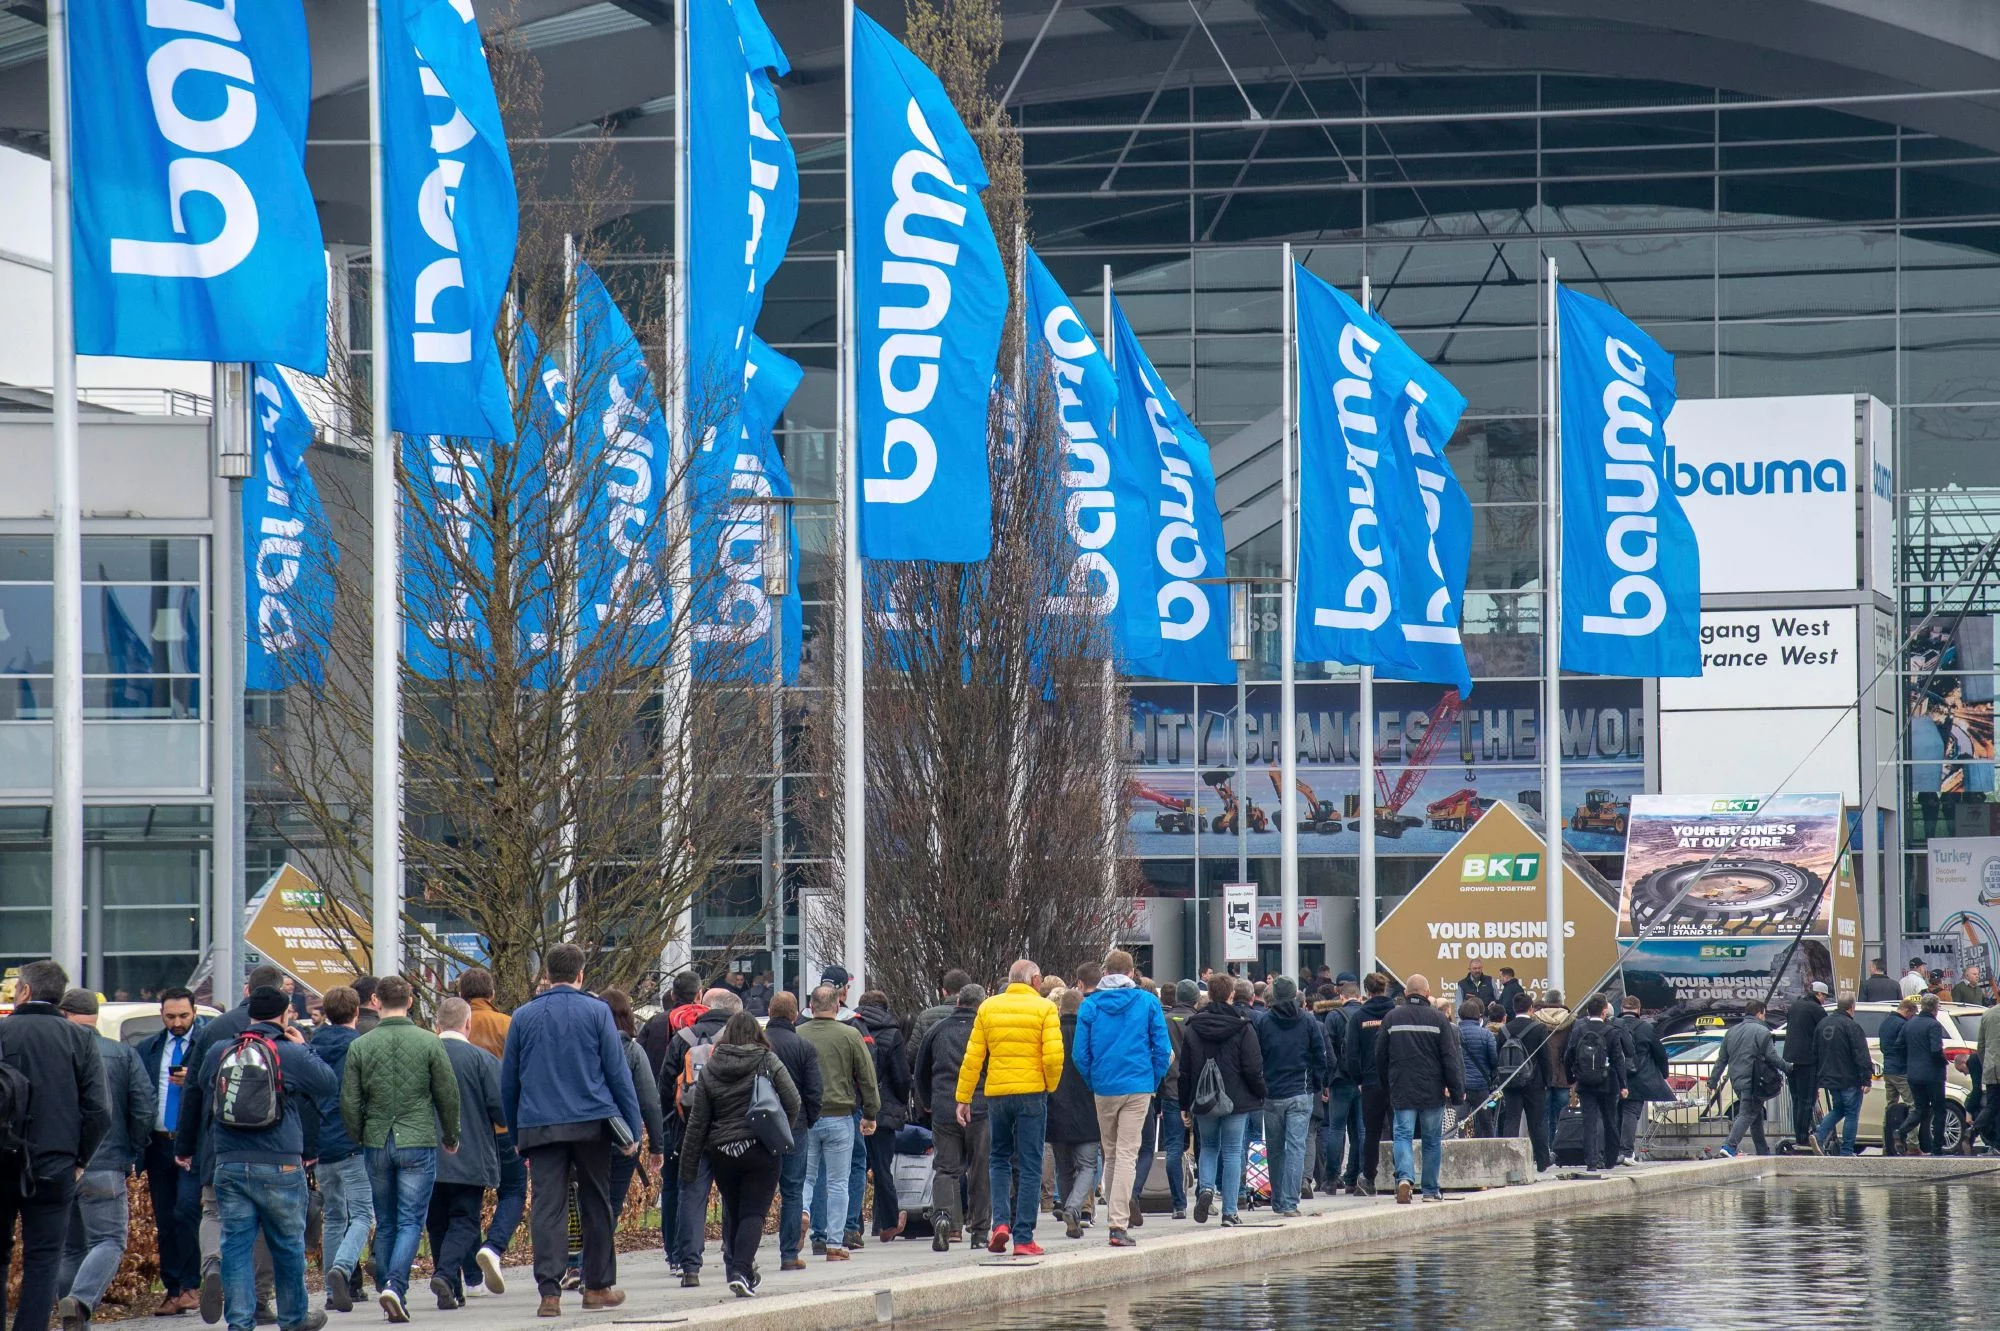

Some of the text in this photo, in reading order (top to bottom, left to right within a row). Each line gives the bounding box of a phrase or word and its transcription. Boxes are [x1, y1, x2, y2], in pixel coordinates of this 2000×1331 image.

[1665, 445, 1847, 497] bauma
[1583, 334, 1667, 637] bauma
[1771, 617, 1830, 637] West
[1701, 645, 1839, 667] rance West
[1456, 708, 1537, 761] THE
[1712, 800, 1760, 812] BKT
[1671, 824, 1796, 837] YOUR BUSINESS
[1677, 837, 1697, 848] AT
[1740, 836, 1786, 848] CORE.
[1933, 849, 1972, 865] Turkey
[1462, 857, 1538, 878] BKT
[273, 926, 306, 937] YOUR
[1427, 920, 1576, 939] YOUR BUSINS
[1437, 942, 1462, 959] AT
[1465, 942, 1507, 959] OUR
[1701, 947, 1746, 956] BKT
[1530, 978, 1549, 989] A6
[1664, 976, 1711, 988] YOUR
[1675, 988, 1696, 1000] AT
[1698, 988, 1734, 1000] OUR
